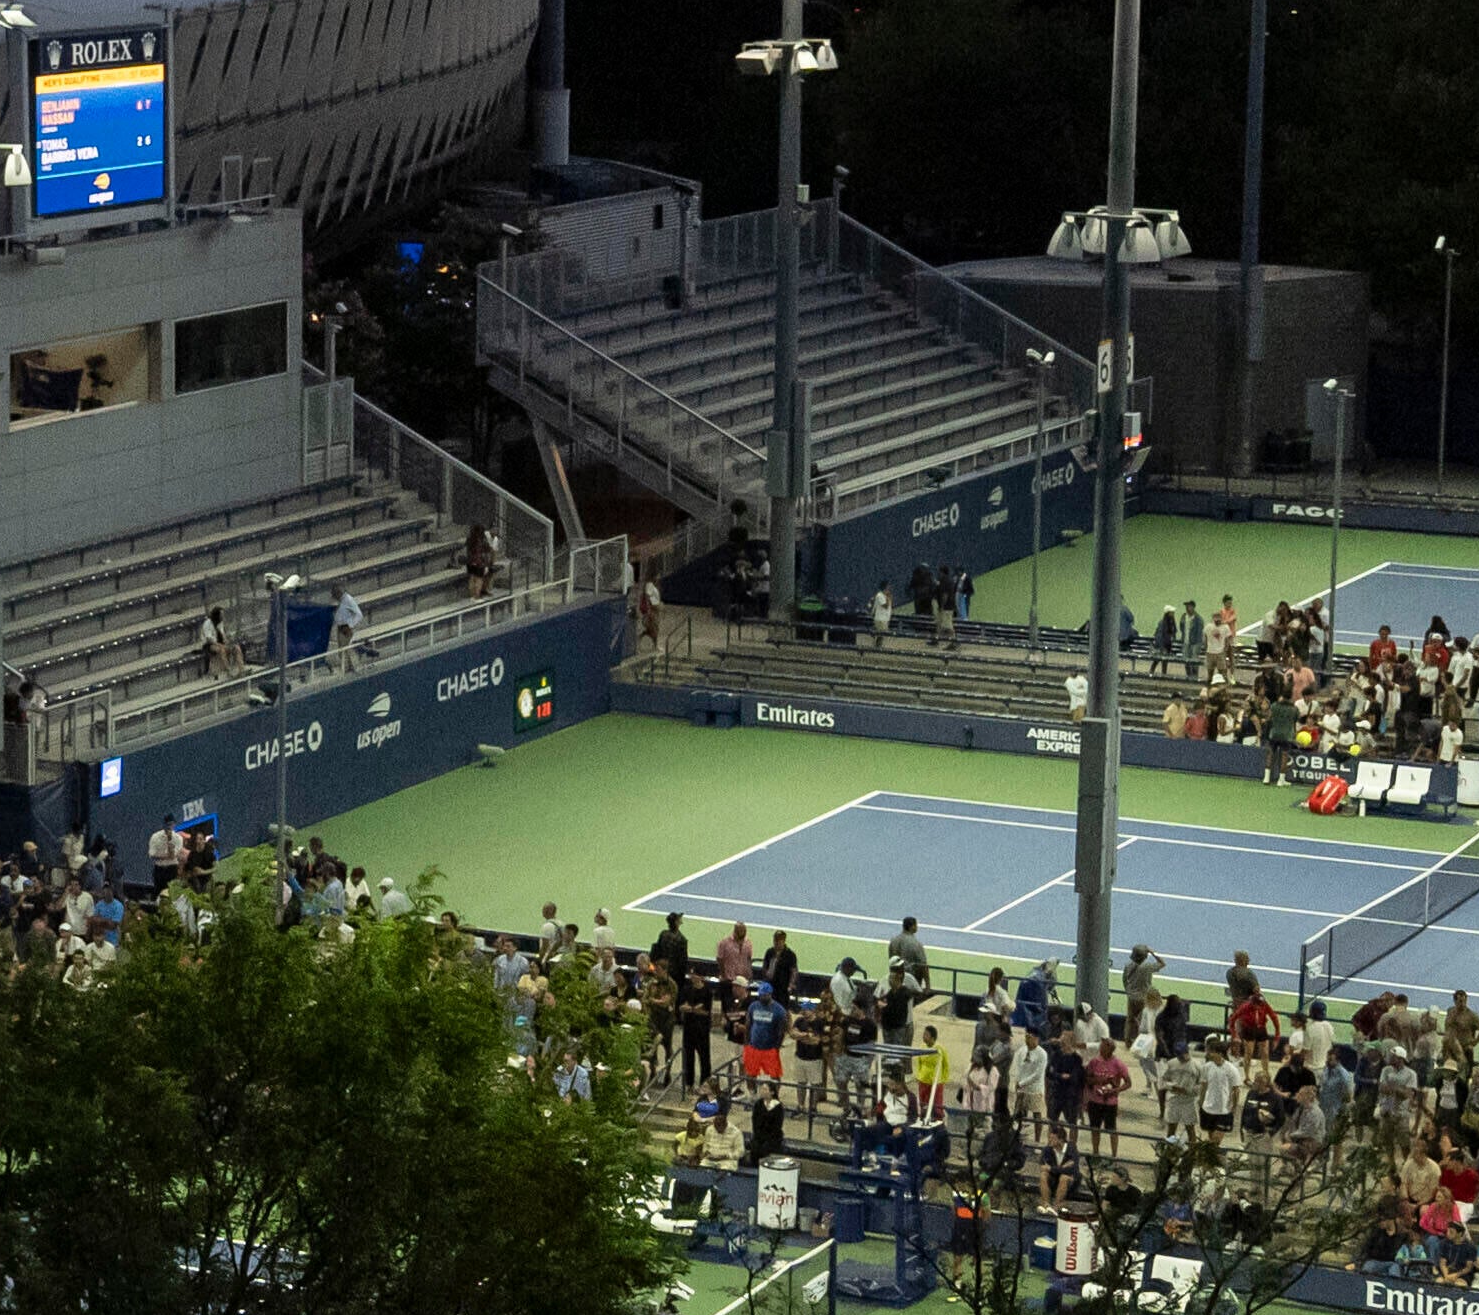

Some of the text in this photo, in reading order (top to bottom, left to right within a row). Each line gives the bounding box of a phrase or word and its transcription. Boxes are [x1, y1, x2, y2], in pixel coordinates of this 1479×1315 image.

[71, 38, 133, 66] ROLEX
[1101, 351, 1109, 383] 6
[912, 508, 950, 537] CHASE
[437, 664, 489, 702] CHASE
[757, 702, 835, 728] Emirates
[357, 720, 402, 750] us open
[1036, 739, 1081, 754] EXPRE
[182, 797, 206, 822] IBM
[758, 1192, 794, 1206] evian
[1064, 1226, 1079, 1271] Wilson
